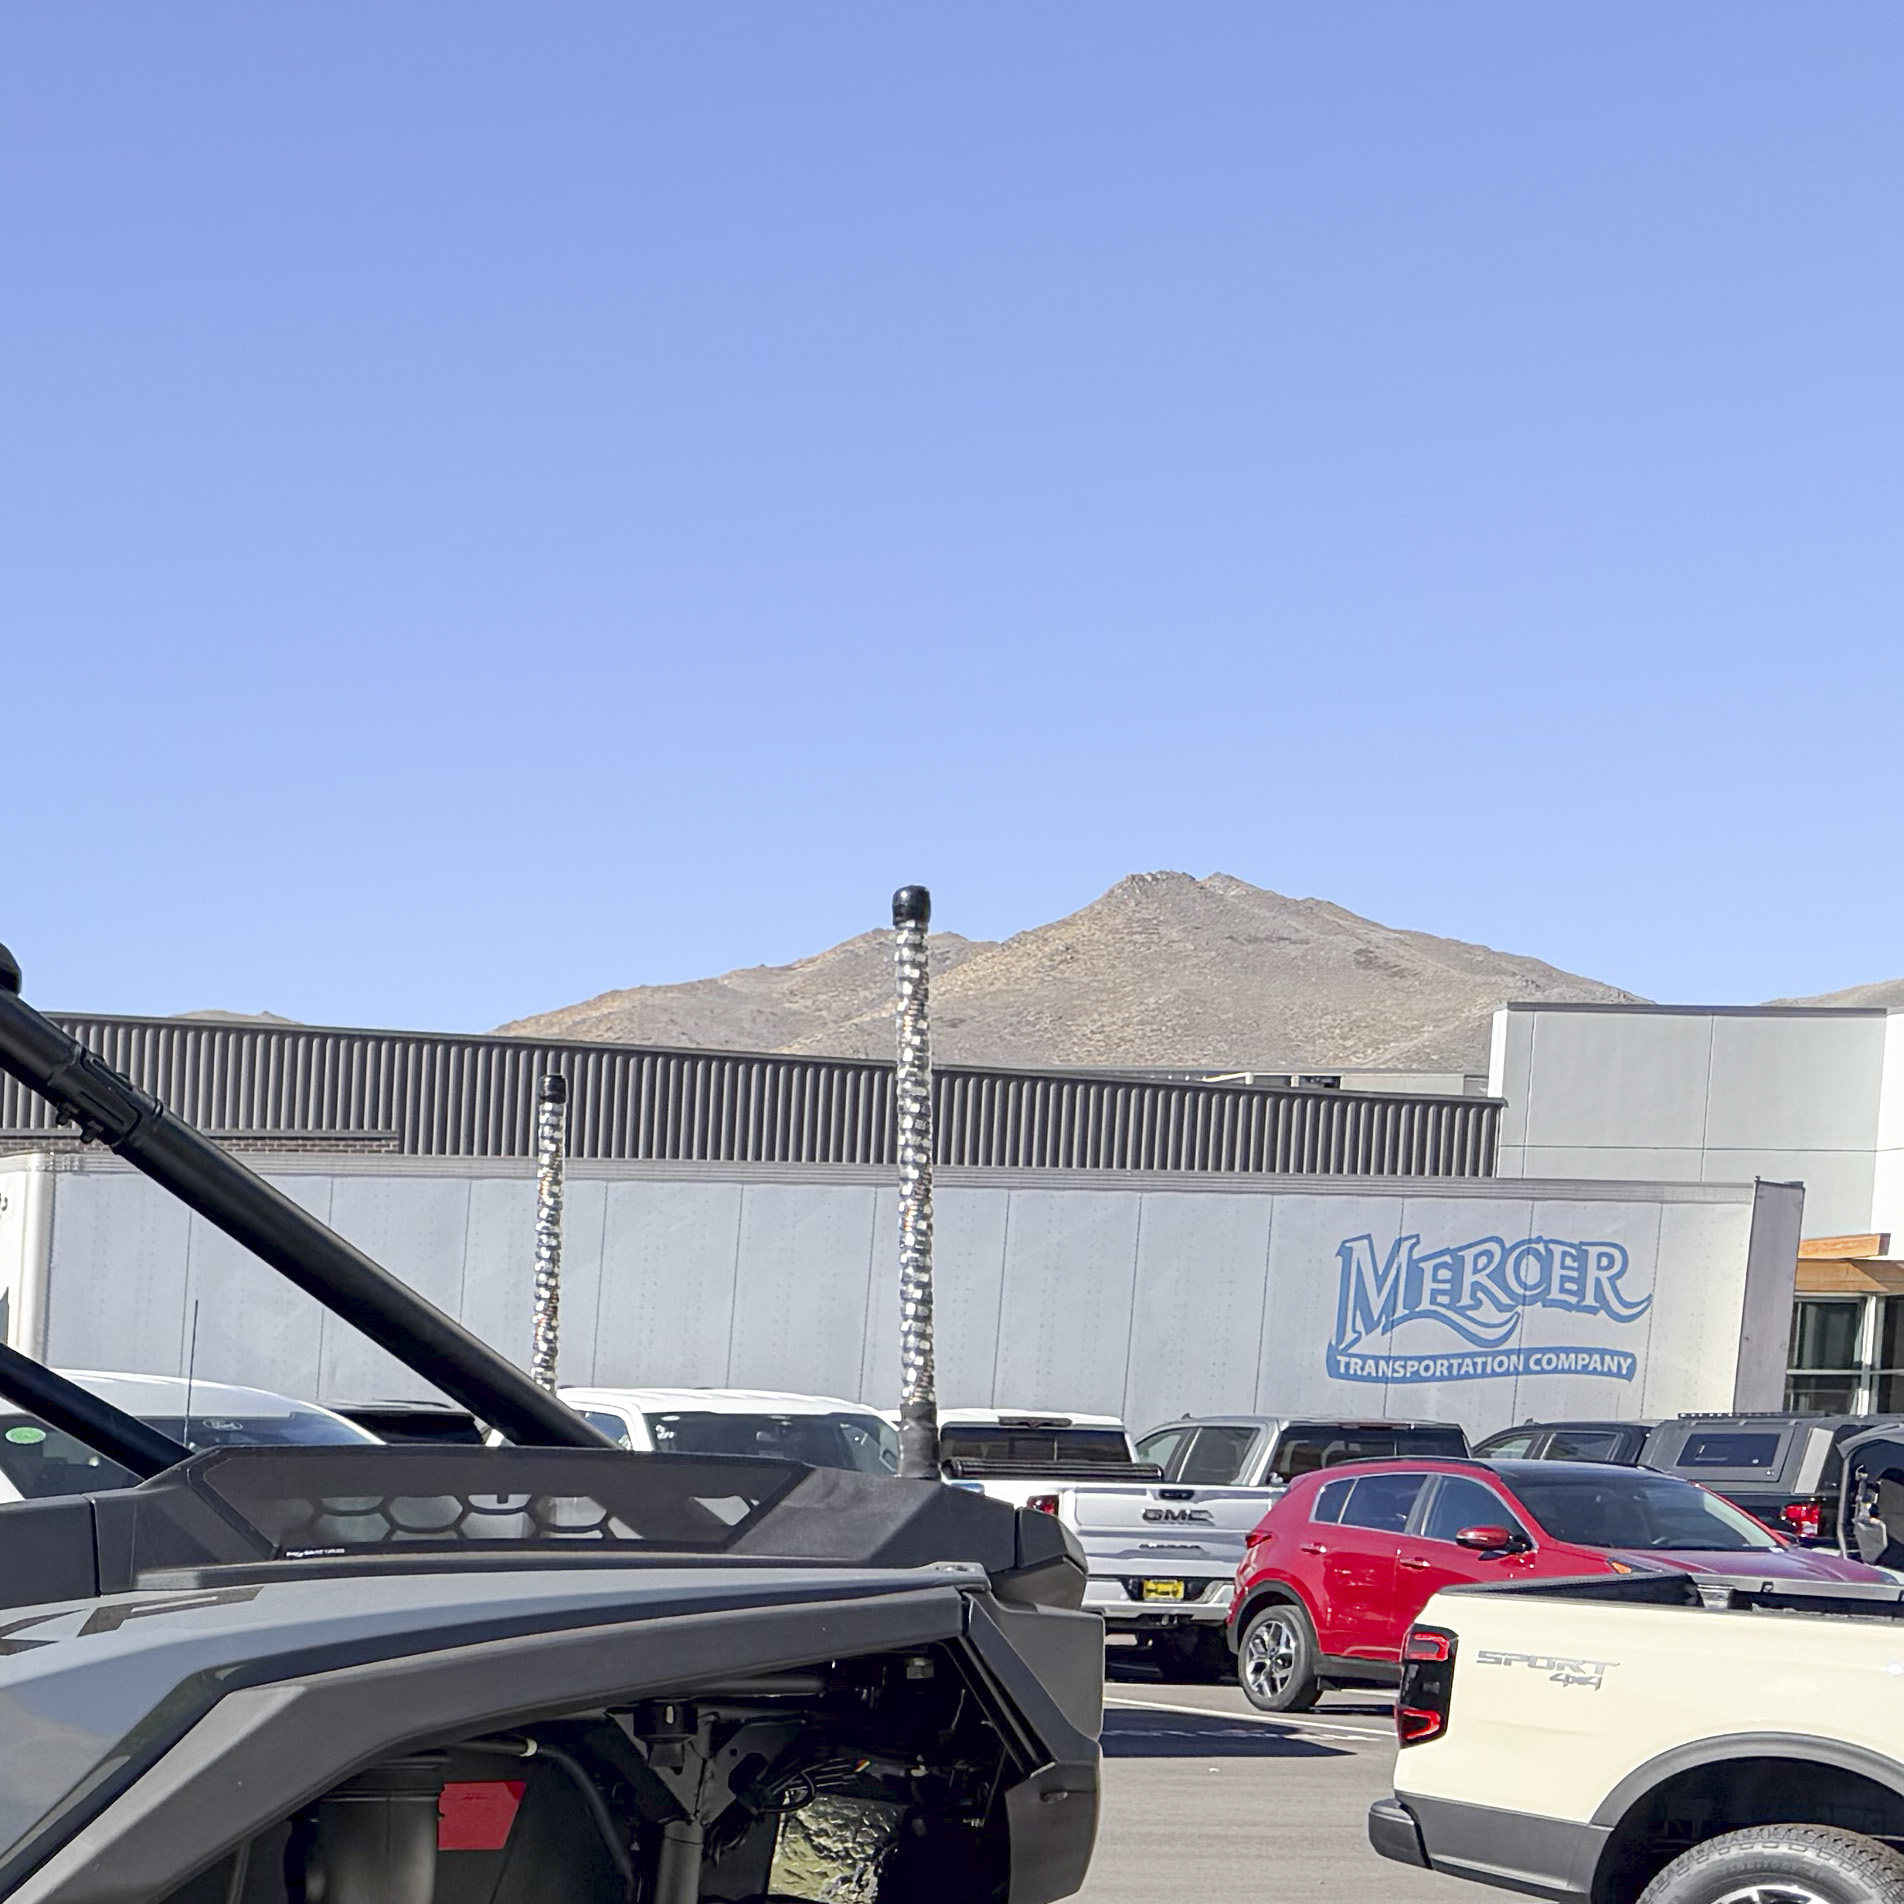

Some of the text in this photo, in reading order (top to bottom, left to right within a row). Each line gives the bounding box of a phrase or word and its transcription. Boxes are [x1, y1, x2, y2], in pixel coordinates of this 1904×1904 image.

[1334, 1233, 1654, 1353] MERCER
[1335, 1352, 1633, 1379] TRANSPORTATION COMPANY
[1142, 1509, 1215, 1527] GMC
[1476, 1650, 1621, 1676] SPORT
